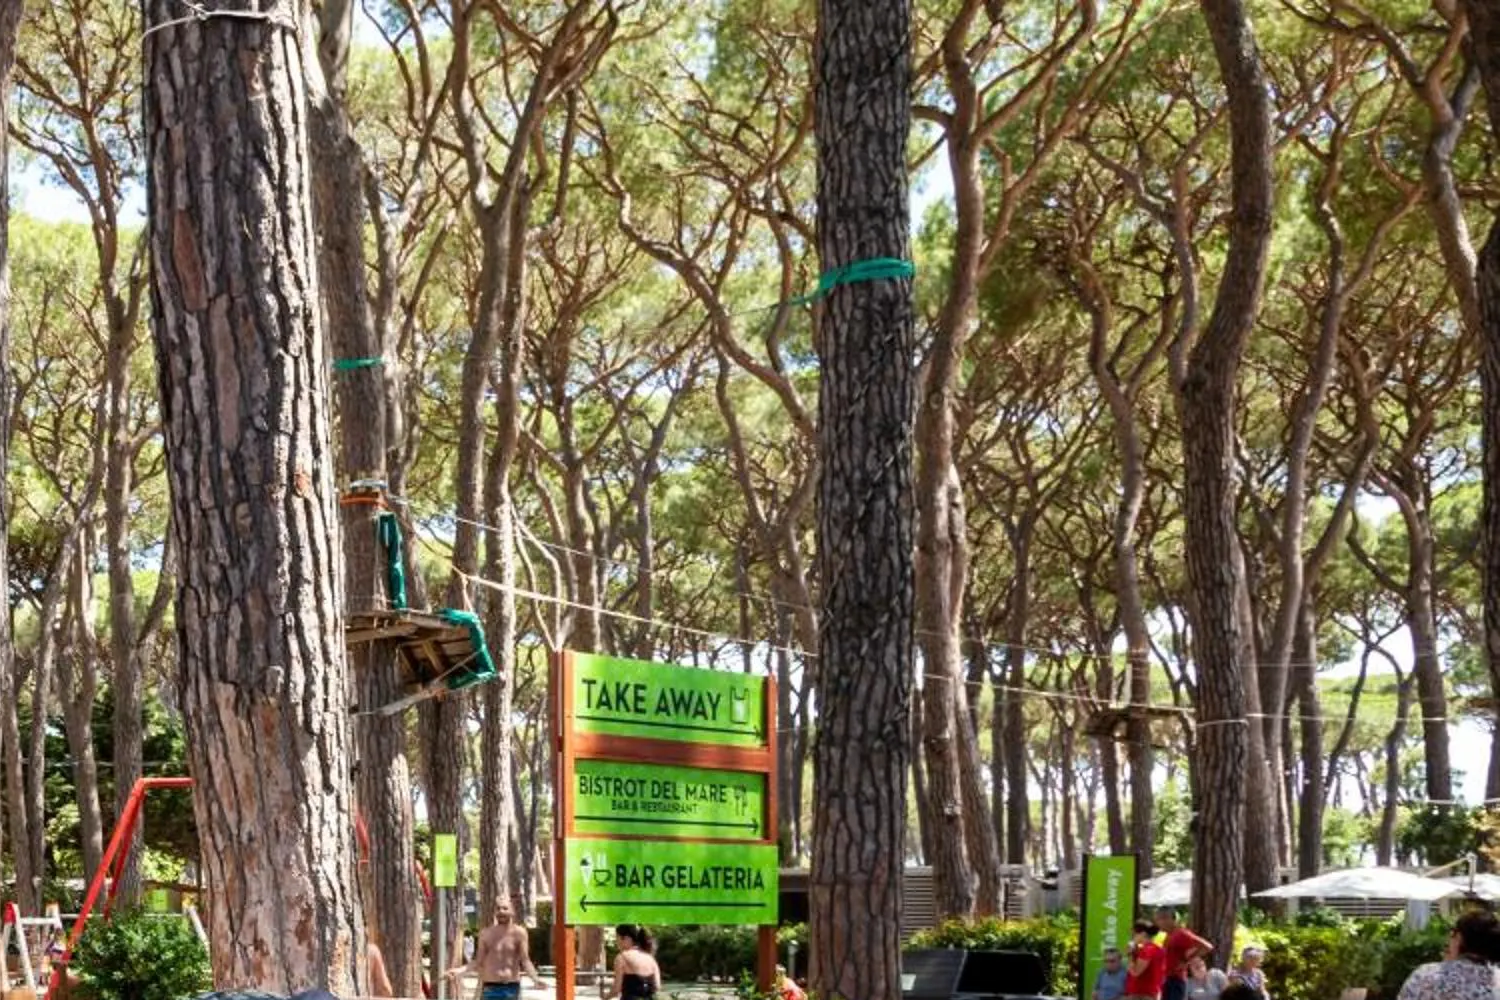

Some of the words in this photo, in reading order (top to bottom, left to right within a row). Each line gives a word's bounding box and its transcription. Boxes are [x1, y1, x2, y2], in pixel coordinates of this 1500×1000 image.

[582, 679, 647, 714] TAKE
[654, 688, 721, 721] AWAY
[579, 775, 646, 799] BISTROT
[651, 780, 681, 801] DEL
[685, 783, 728, 804] MARE
[611, 800, 630, 811] BAR
[615, 863, 656, 889] BAR
[661, 865, 765, 890] GELATERIA
[1102, 867, 1123, 912] Away
